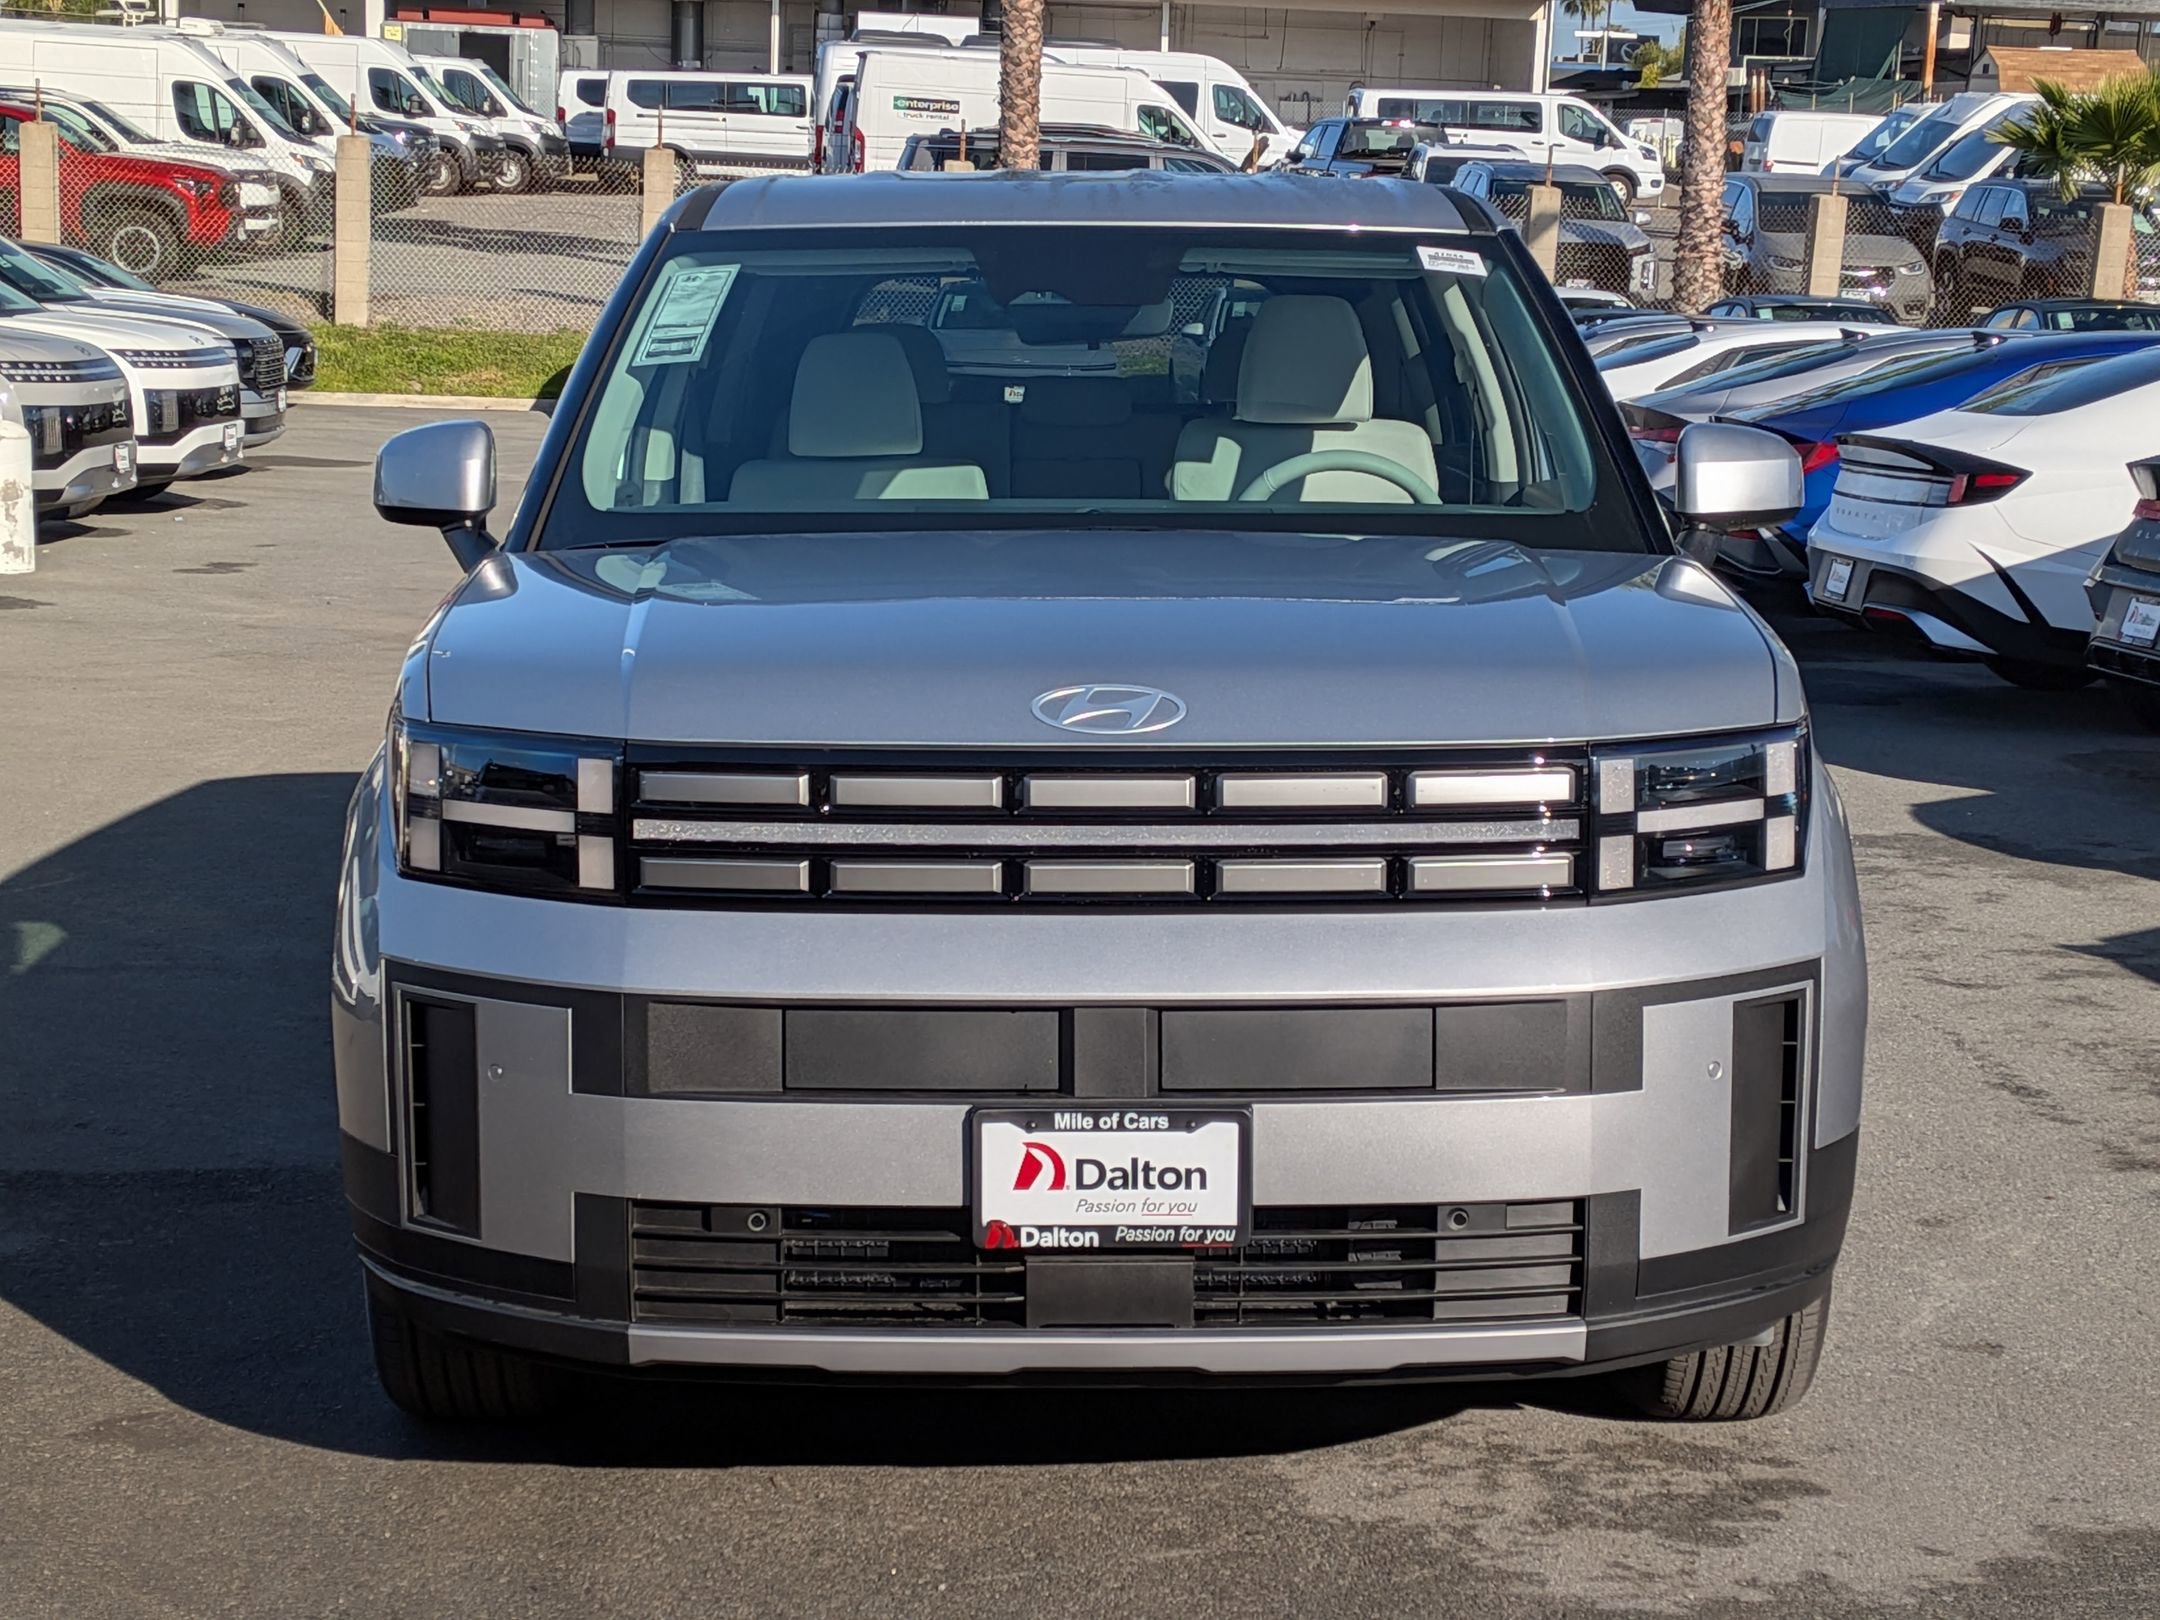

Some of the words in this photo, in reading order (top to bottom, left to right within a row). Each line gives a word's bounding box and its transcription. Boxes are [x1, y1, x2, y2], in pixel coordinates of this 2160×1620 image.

[895, 99, 959, 111] enterprise
[1054, 1113, 1094, 1130] Mile
[1098, 1112, 1120, 1130] of
[1124, 1113, 1169, 1130] Cars
[1075, 1157, 1207, 1190] Dalton
[1075, 1198, 1136, 1213] Passion
[1141, 1198, 1165, 1213] for
[1168, 1201, 1198, 1214] you
[1020, 1227, 1100, 1248] Dalton
[1115, 1226, 1175, 1243] Passion
[1178, 1226, 1204, 1242] for
[1204, 1229, 1236, 1244] you
